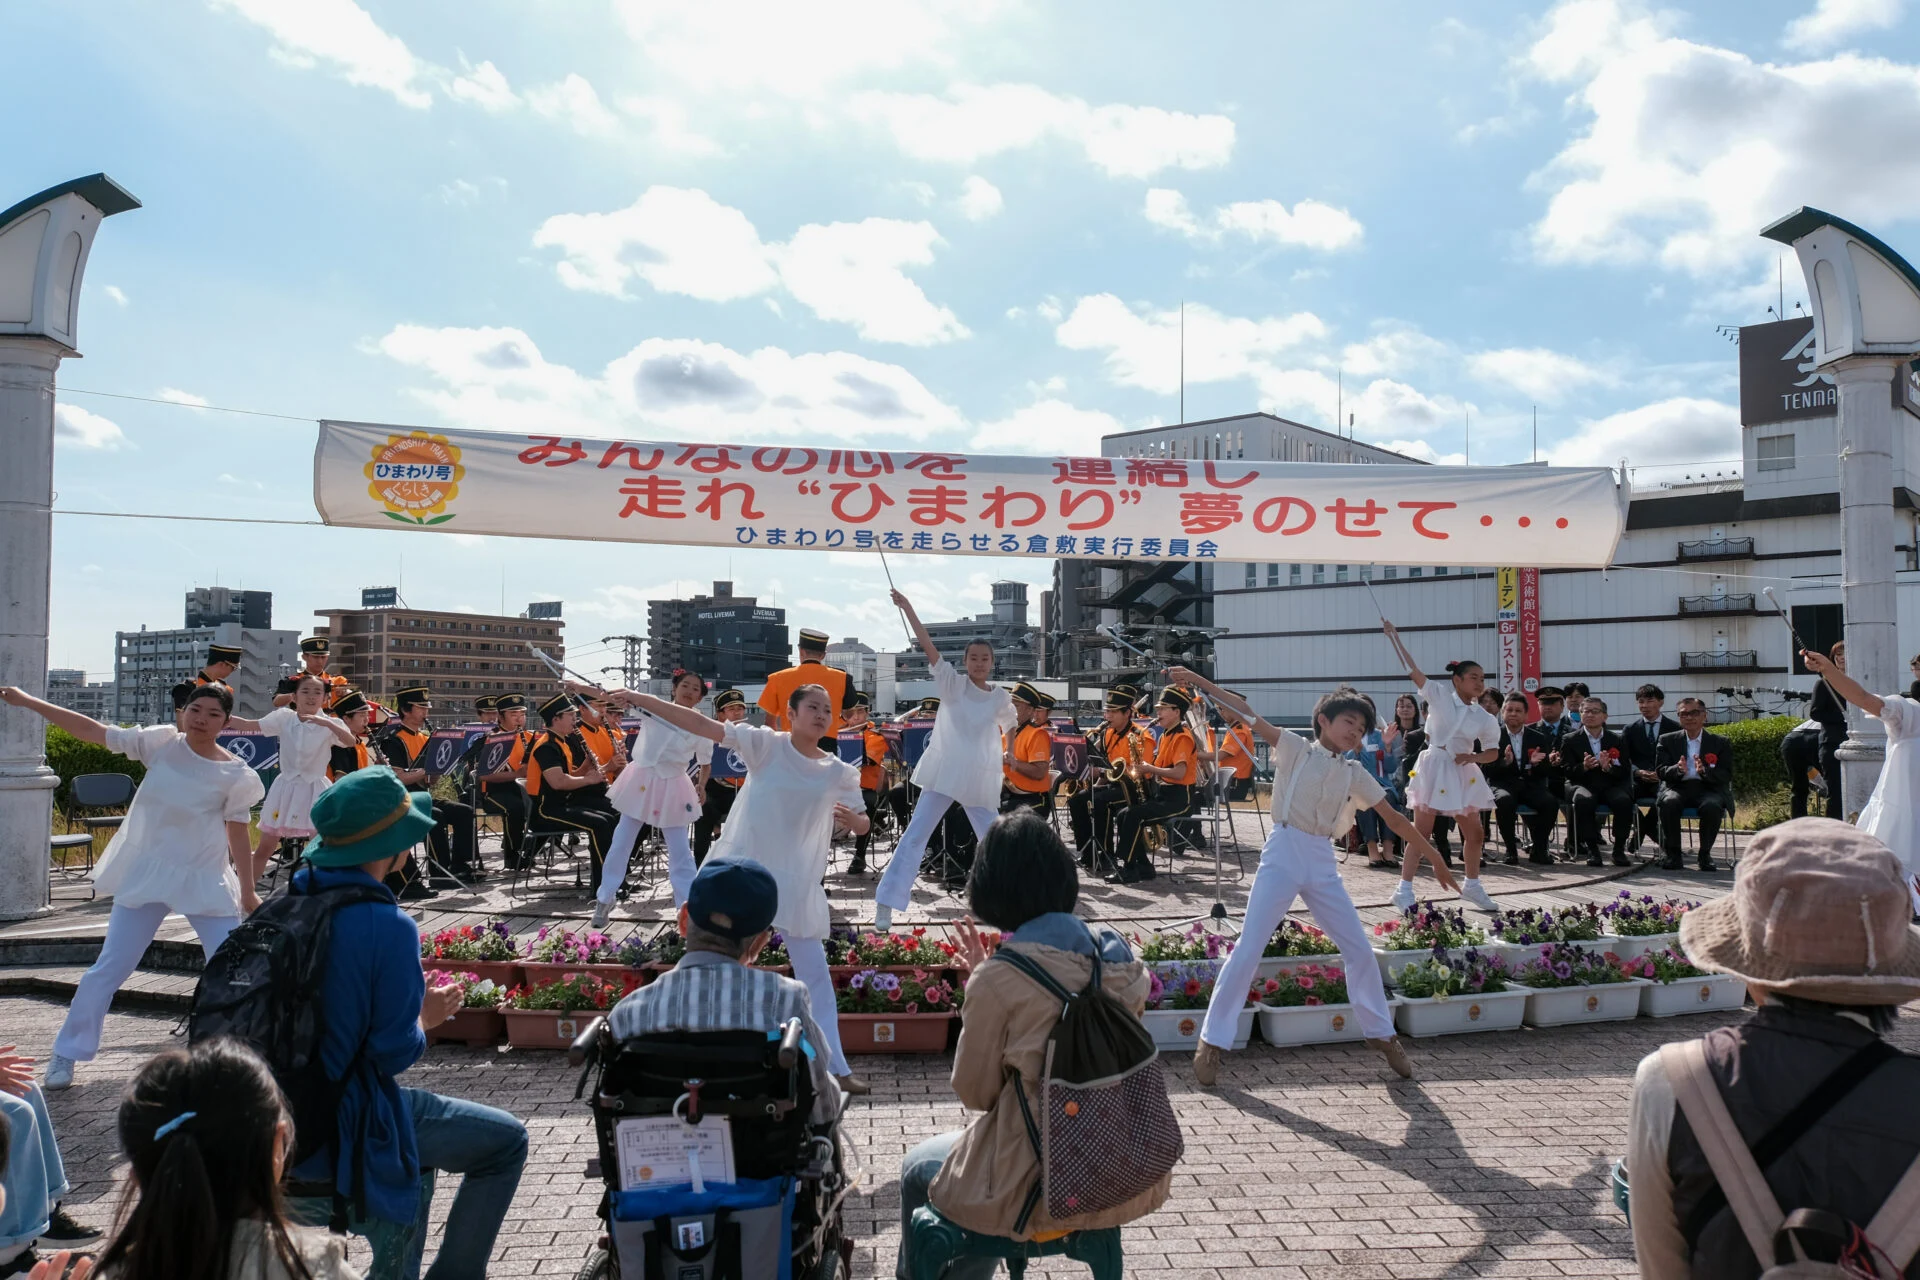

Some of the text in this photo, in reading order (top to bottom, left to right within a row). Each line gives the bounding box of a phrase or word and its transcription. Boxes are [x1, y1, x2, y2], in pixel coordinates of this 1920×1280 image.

[382, 438, 449, 464] FRIENDSHIP TRAIN
[518, 434, 968, 481] みんなの心を
[376, 464, 451, 480] ひまわり号
[392, 481, 430, 497] くらしき
[618, 474, 766, 521] 走れ
[735, 526, 1219, 558] ひまわり号を走らせる倉敷実行委員会
[753, 609, 776, 617] LIVEMAX
[1501, 622, 1515, 633] 6F
